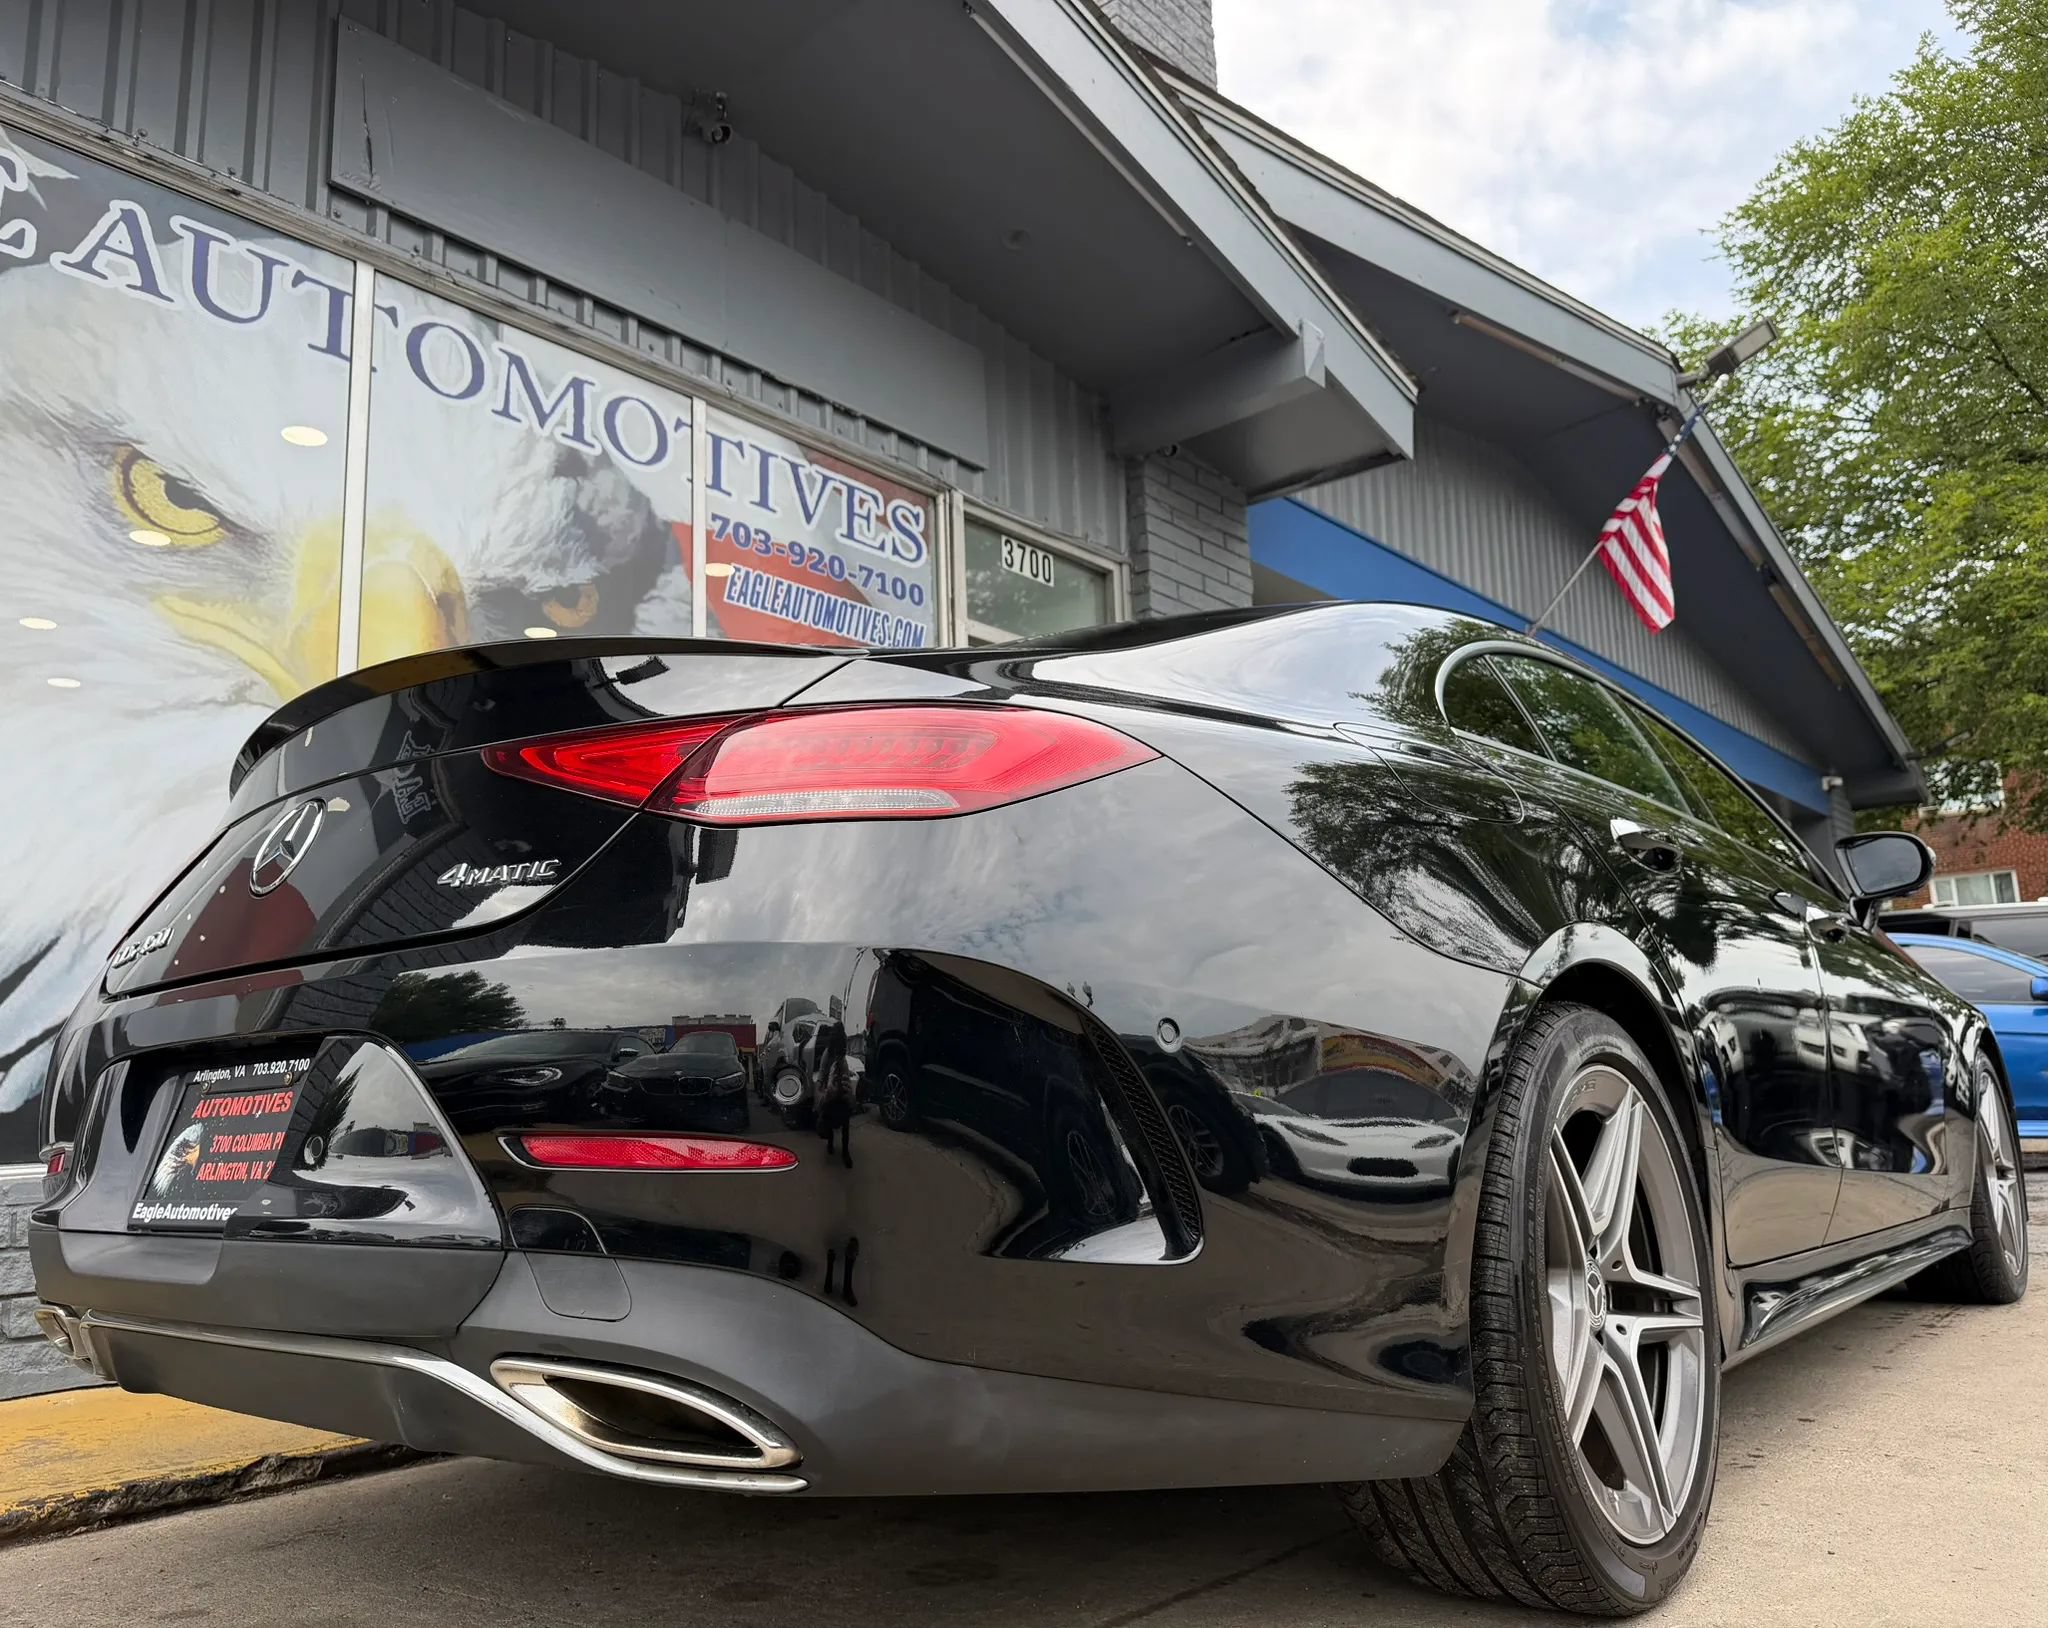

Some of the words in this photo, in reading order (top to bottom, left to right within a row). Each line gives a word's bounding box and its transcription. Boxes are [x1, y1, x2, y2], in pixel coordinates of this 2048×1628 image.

[57, 204, 926, 564] AUTOMOTIVES
[710, 512, 925, 607] 703-920-7100
[1004, 538, 1052, 584] 3700
[725, 564, 926, 647] EAGLEAUTOMOTIVES.COM
[437, 859, 562, 887] 4MATIC
[193, 1069, 231, 1083] Arlington,
[234, 1065, 246, 1077] VA
[252, 1058, 311, 1076] 703.920.7100
[191, 1091, 294, 1119] AUTOMOTIVES
[209, 1134, 233, 1153] 3700
[232, 1132, 270, 1153] COLUMBIA
[195, 1162, 248, 1184] ARLINGTON,
[250, 1160, 264, 1180] VA
